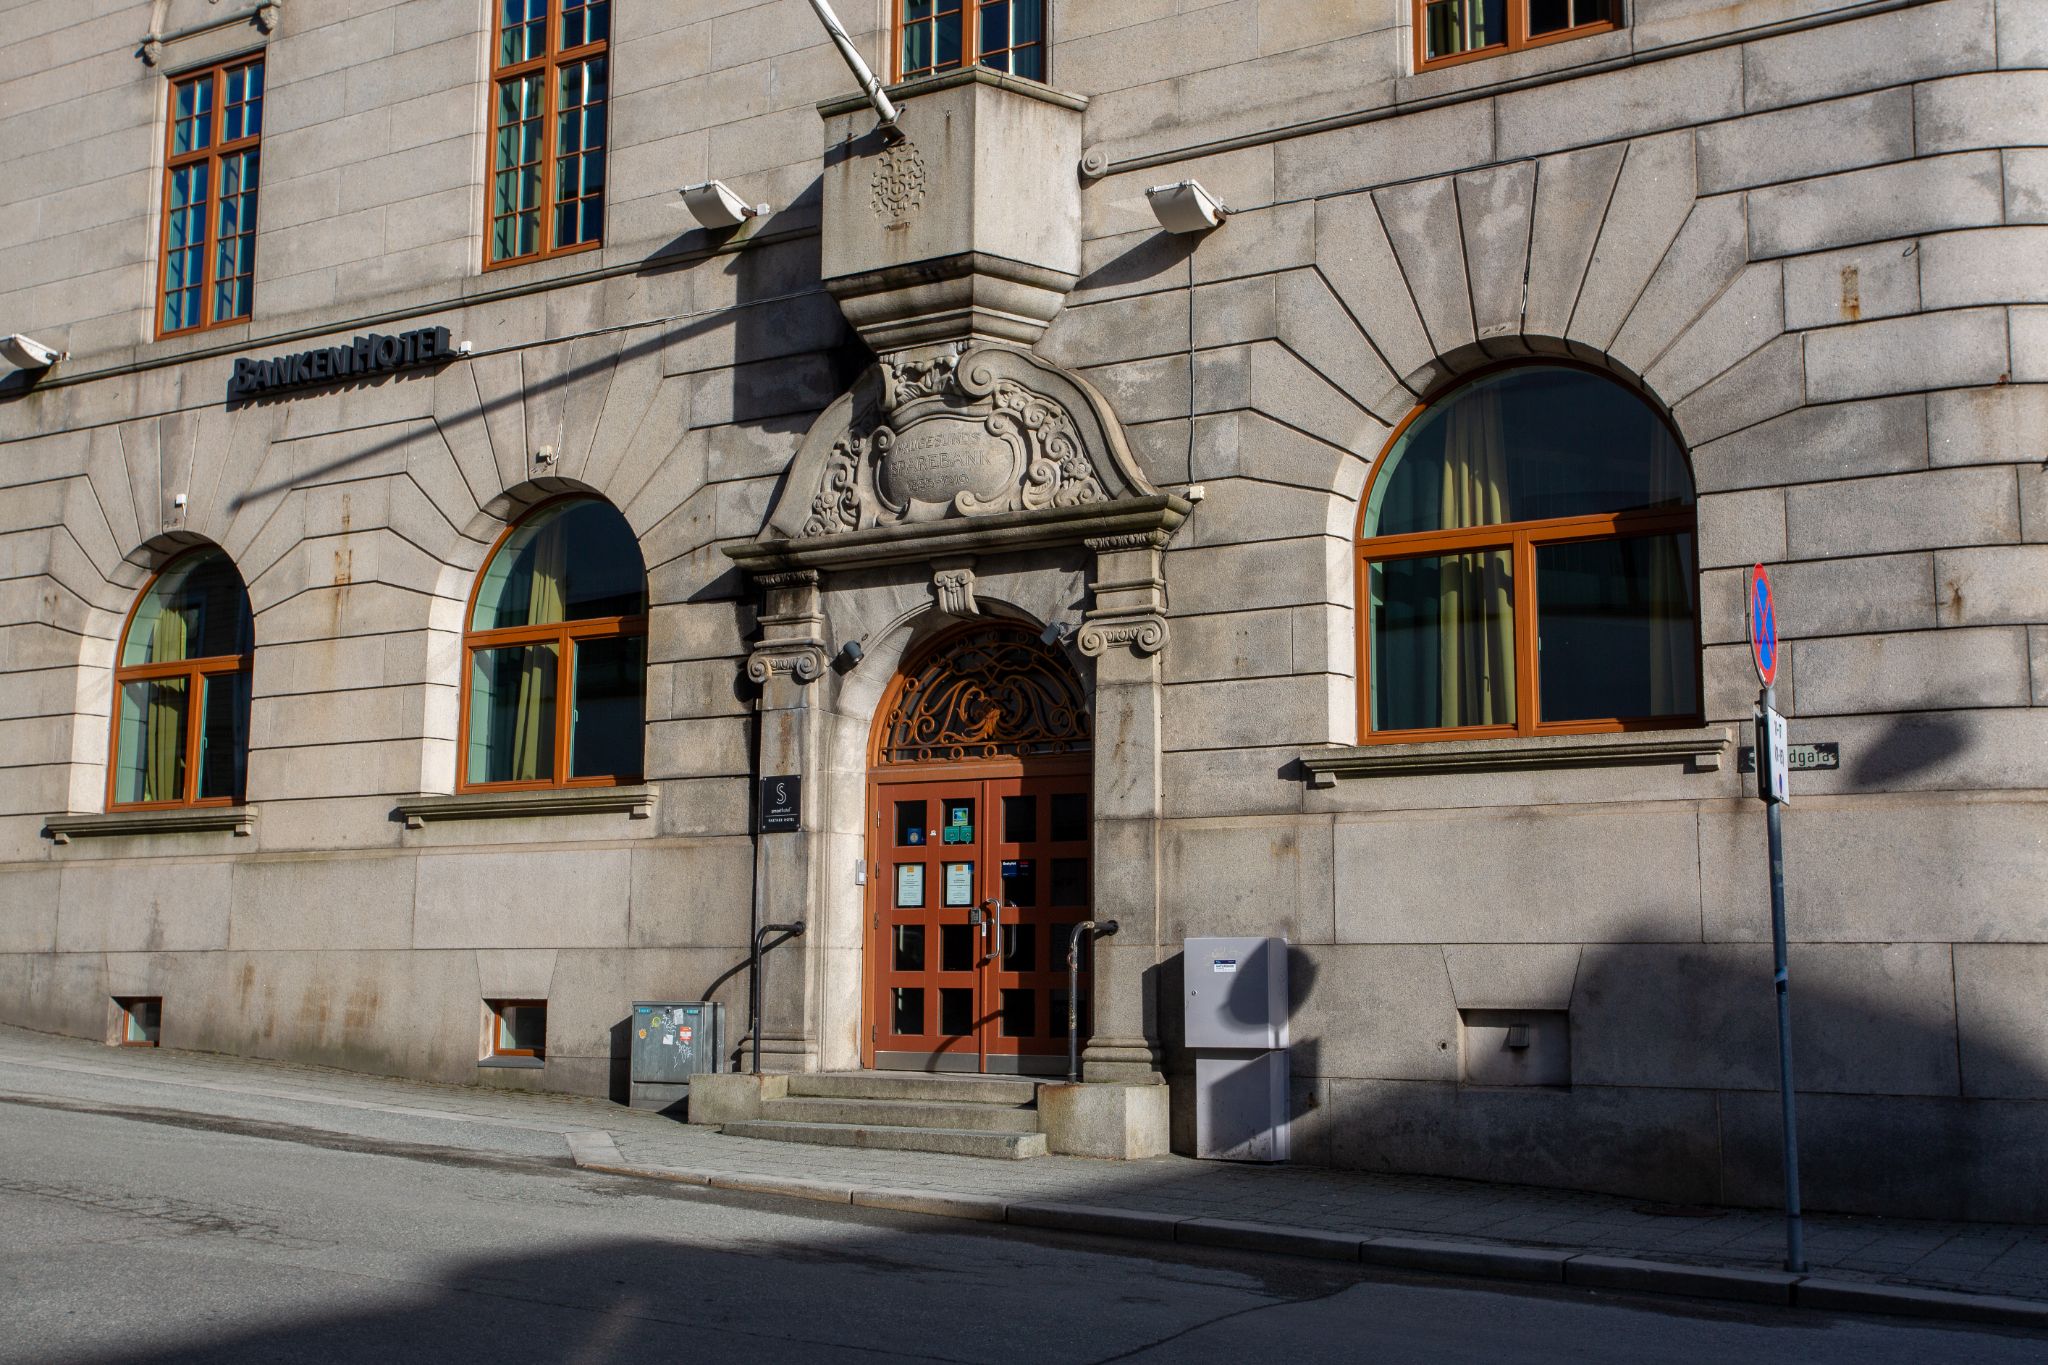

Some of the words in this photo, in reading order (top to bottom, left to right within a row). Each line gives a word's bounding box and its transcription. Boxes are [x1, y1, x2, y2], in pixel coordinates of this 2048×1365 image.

[233, 345, 351, 393] BANKEN
[352, 326, 454, 372] HOTEL
[890, 450, 992, 478] SPAREBANK
